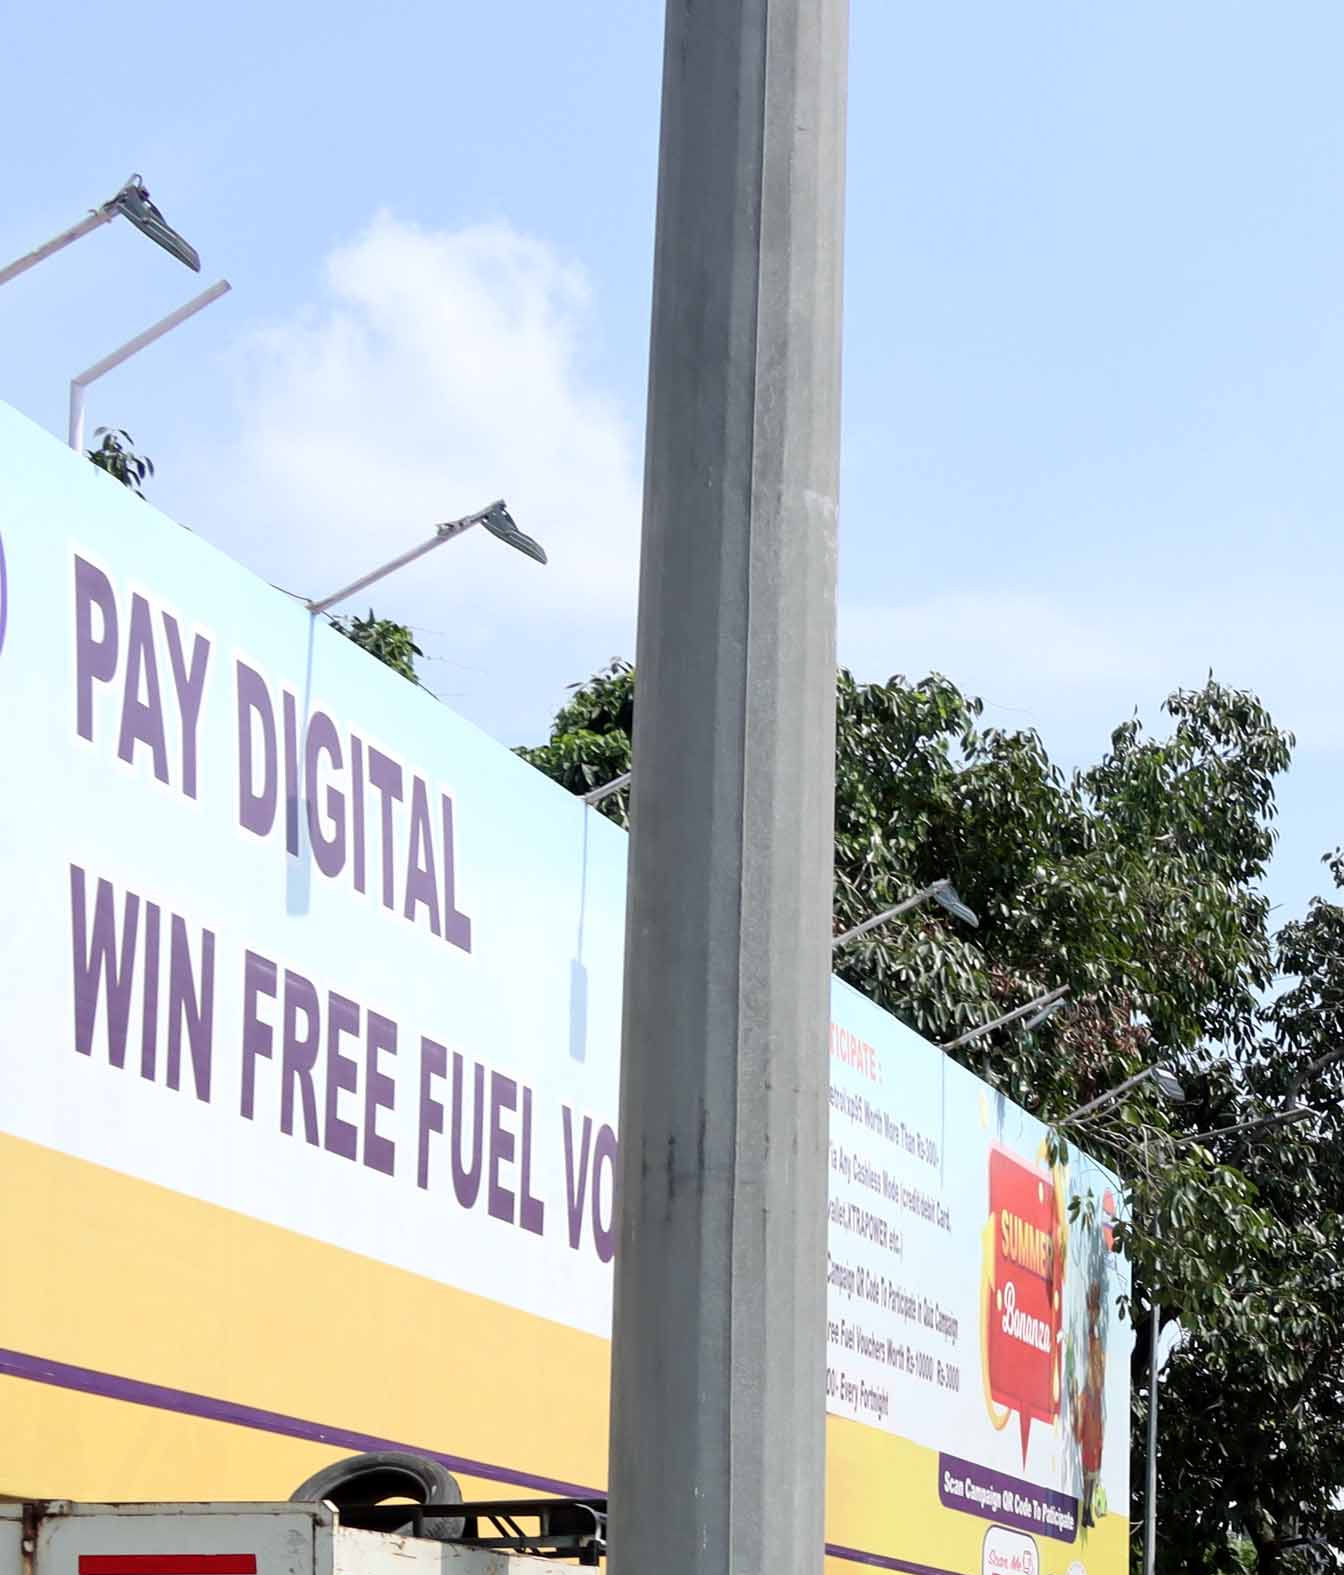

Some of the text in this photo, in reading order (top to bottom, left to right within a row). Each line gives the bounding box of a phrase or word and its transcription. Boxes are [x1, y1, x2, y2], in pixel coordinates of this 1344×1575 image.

[74, 553, 471, 954] PAY DIGITAL
[69, 863, 618, 1264] WIN FREE FUEL VO
[829, 1024, 876, 1080] TICIPATE
[840, 1318, 855, 1351] Fuel
[1002, 1281, 1051, 1353] Bonanza
[839, 1370, 858, 1411] Every
[944, 1472, 964, 1495] Scan
[965, 1478, 1001, 1512] Campaign
[1003, 1491, 1014, 1513] QR
[1015, 1493, 1031, 1518] Code
